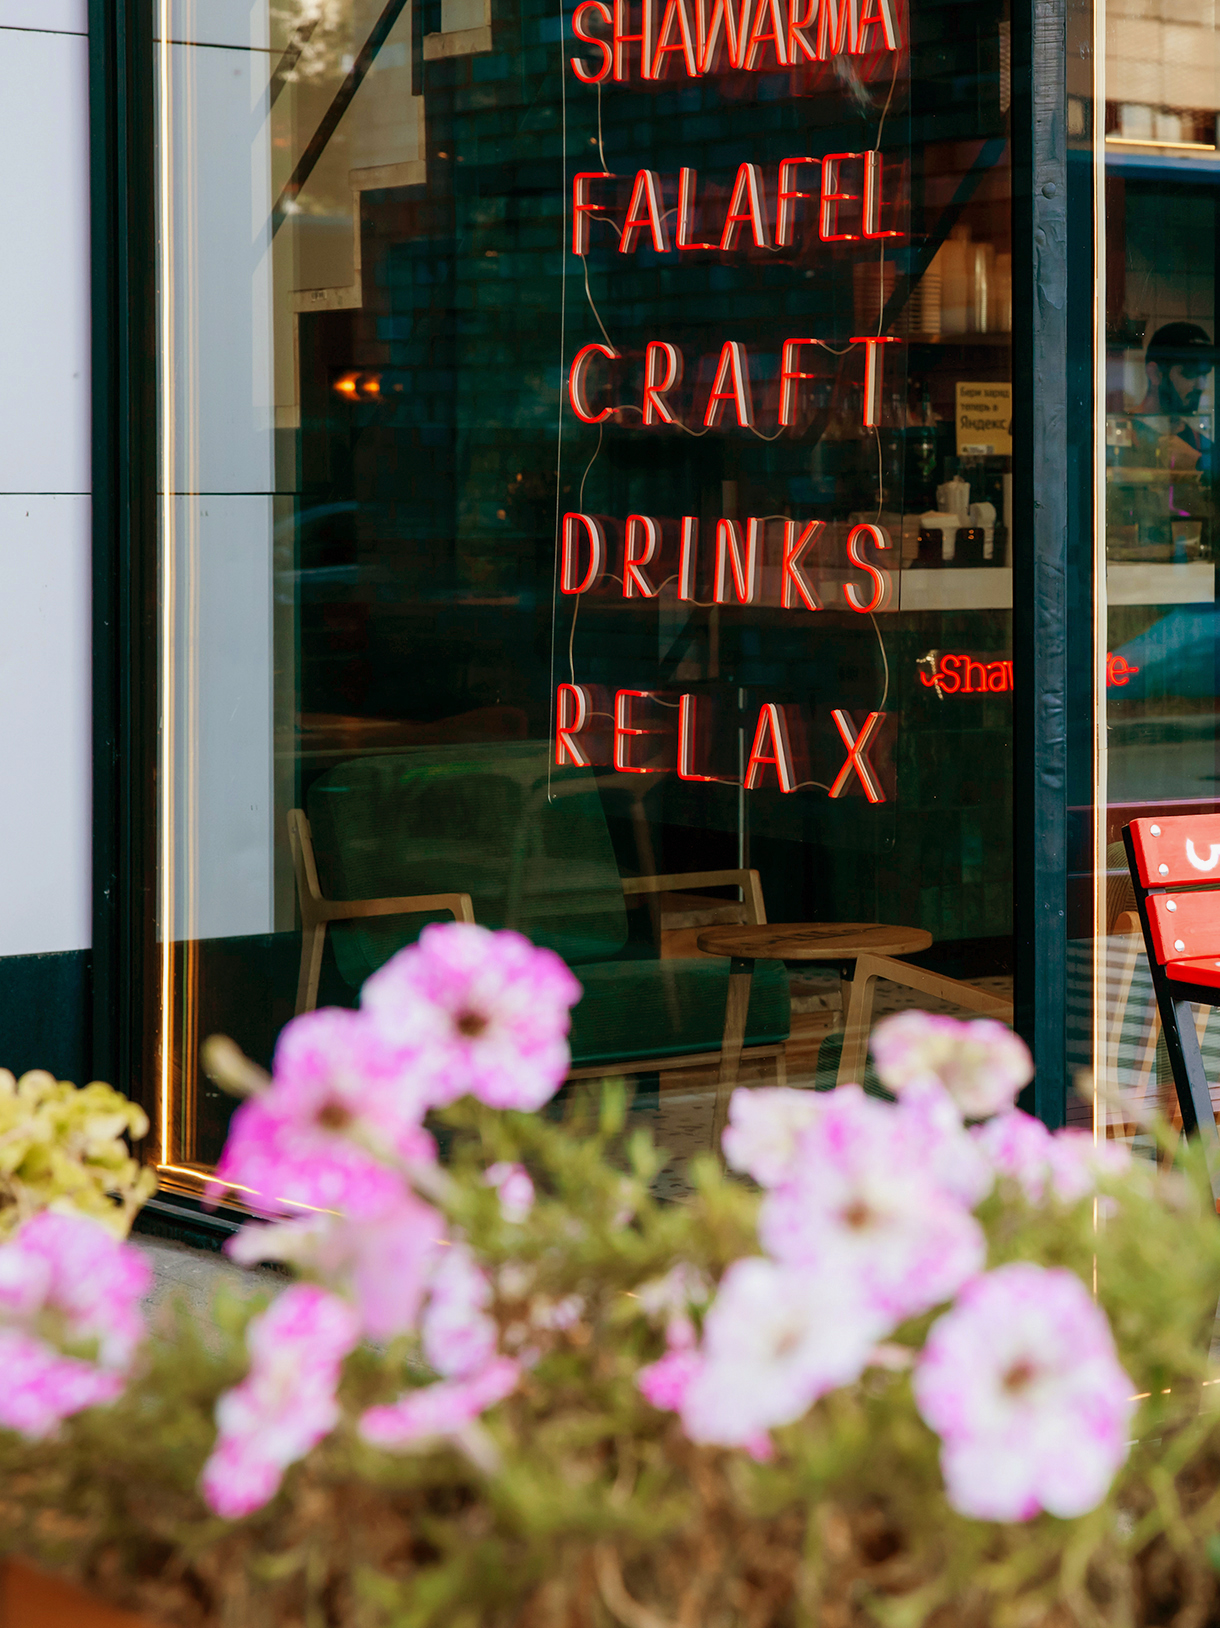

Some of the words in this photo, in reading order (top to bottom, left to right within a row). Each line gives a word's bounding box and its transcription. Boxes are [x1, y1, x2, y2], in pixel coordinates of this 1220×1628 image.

[571, 0, 897, 83] SHAWARMA
[572, 150, 904, 255] FALAFEL
[569, 336, 901, 427] CRAFT
[960, 415, 1006, 431] Яндекс
[560, 512, 892, 613] DRINKS
[555, 683, 887, 803] RELAX
